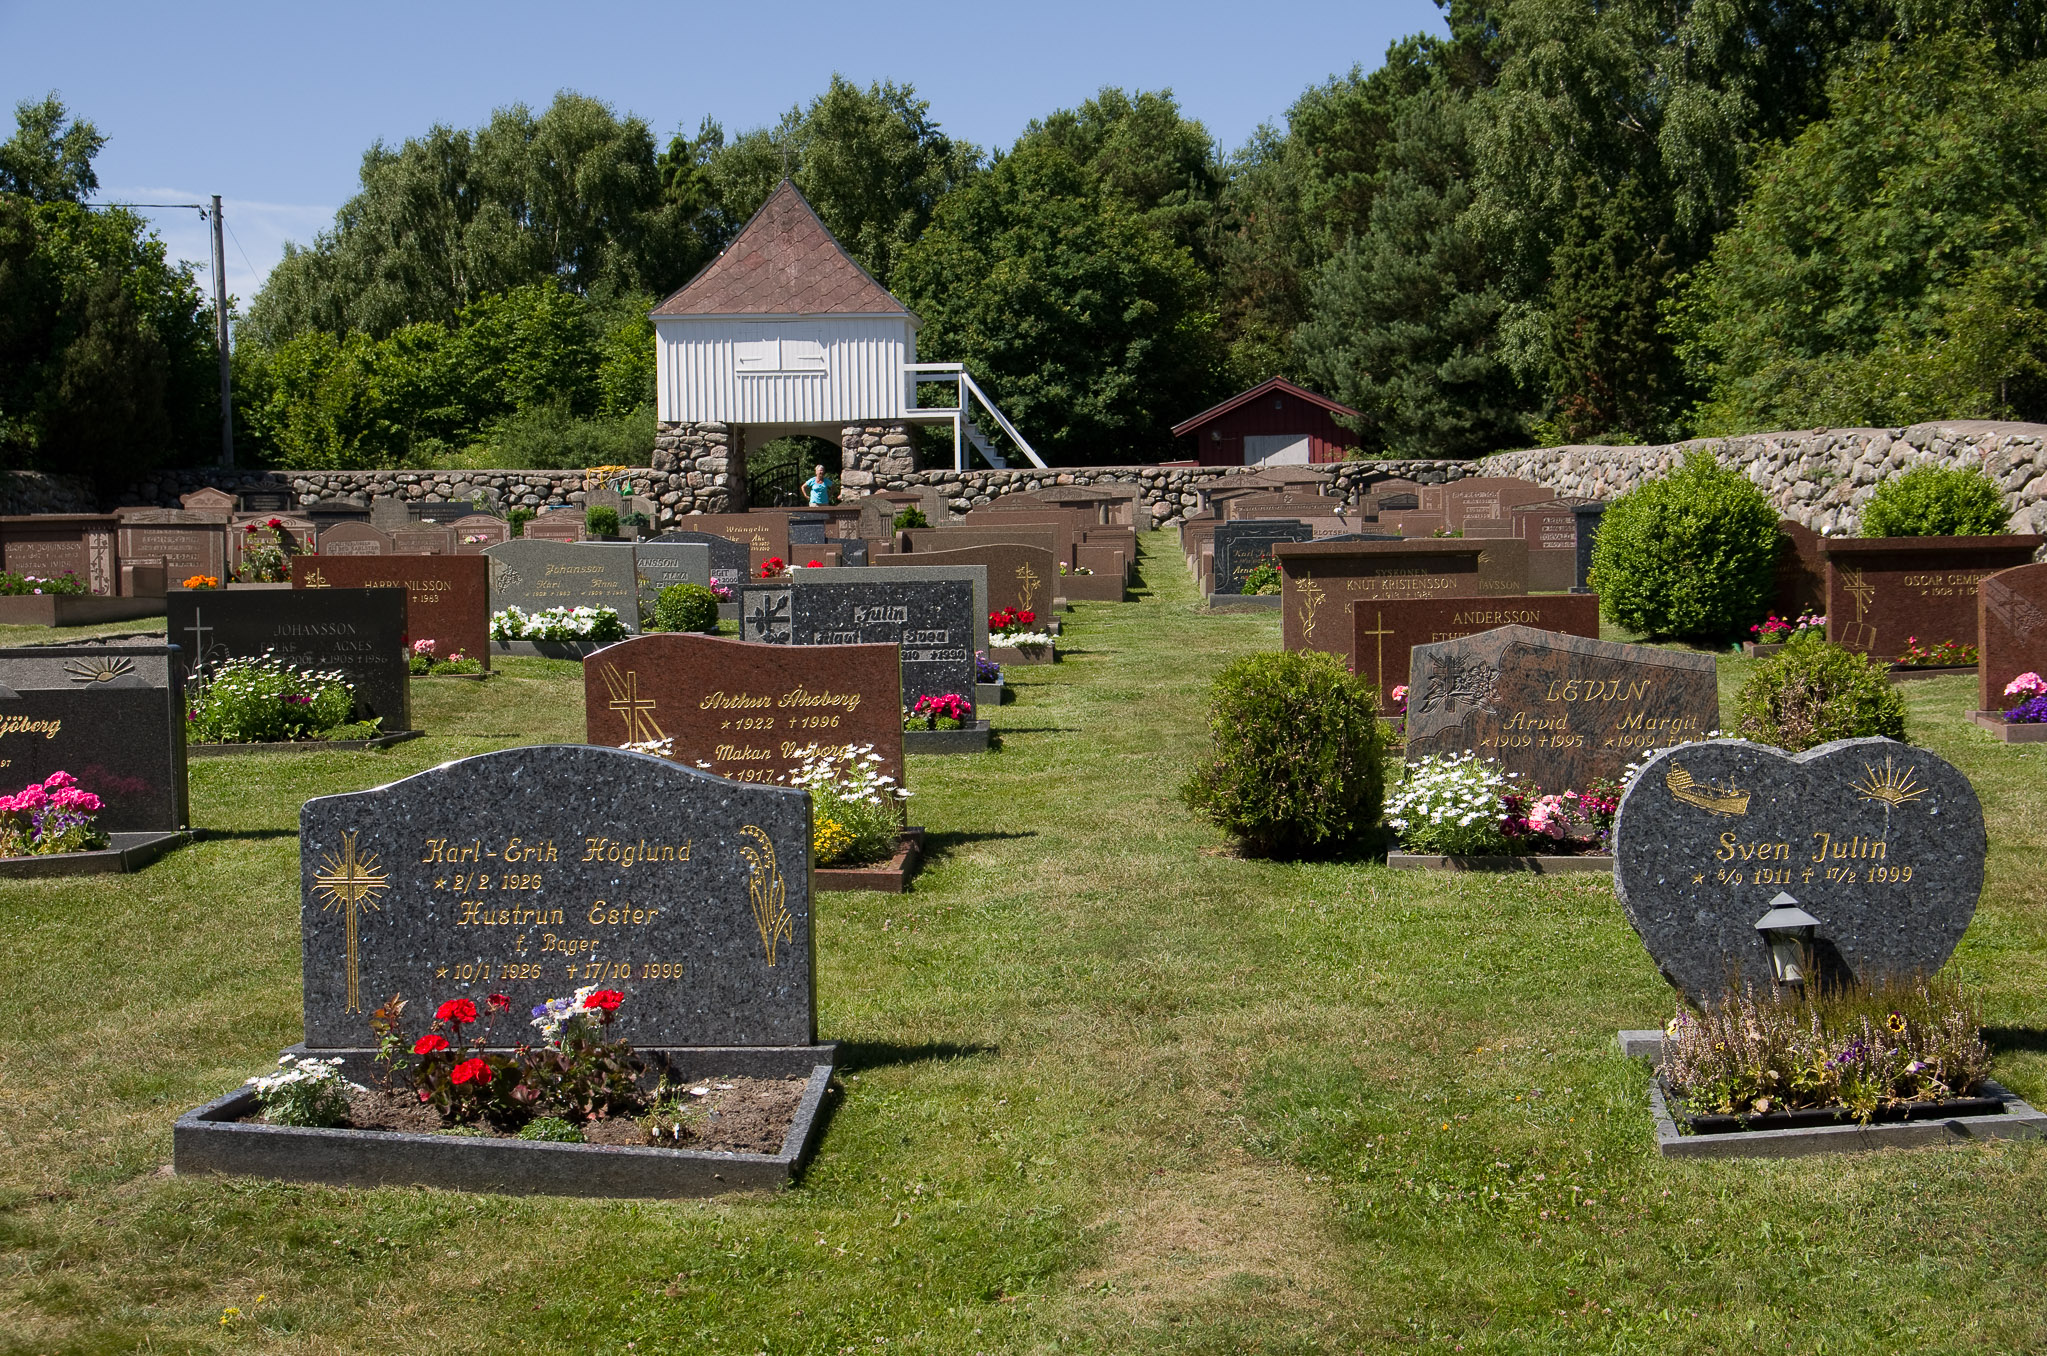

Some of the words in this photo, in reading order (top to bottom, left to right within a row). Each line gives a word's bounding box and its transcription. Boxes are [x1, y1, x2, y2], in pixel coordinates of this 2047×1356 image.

[545, 563, 605, 576] Johansson
[405, 581, 452, 591] NILSSON
[1347, 579, 1376, 591] KNUT
[1382, 578, 1458, 590] KRISTENSSON
[1904, 575, 1943, 586] OSCAR
[856, 604, 907, 622] Julin
[1453, 609, 1541, 626] ANDERSSON
[273, 623, 357, 637] JOHANSSON
[904, 627, 947, 643] Svea
[1432, 632, 1470, 643] ETH
[260, 642, 297, 653] FOLKE
[333, 641, 373, 651] AGNES
[699, 690, 772, 710] Arthur
[777, 683, 861, 712] Åhsberg
[1546, 679, 1651, 702] LEVIN
[735, 717, 775, 730] 1922
[801, 715, 841, 729] 1996
[1503, 711, 1569, 731] Arvid
[1616, 711, 1698, 735] Margit
[1493, 735, 1532, 748] 1909
[1549, 735, 1584, 748] 1995
[1617, 734, 1655, 748] 1909
[715, 743, 772, 761] Makan
[737, 769, 775, 783] 1917
[581, 837, 693, 867] Höglund
[1715, 831, 1790, 862] Sven
[1811, 831, 1887, 863] Julin
[501, 874, 543, 890] 1926
[1717, 867, 1744, 886] 8/9
[1752, 868, 1792, 885] 1911
[1826, 866, 1857, 884] 17/2
[1867, 865, 1914, 884] 1999
[456, 900, 565, 926] Hustrun
[587, 900, 660, 926] Ester
[541, 933, 600, 956] Bager
[453, 962, 491, 983] 10/1
[501, 963, 543, 980] 1926
[583, 961, 632, 983] 17/10
[642, 962, 685, 980] 1999
